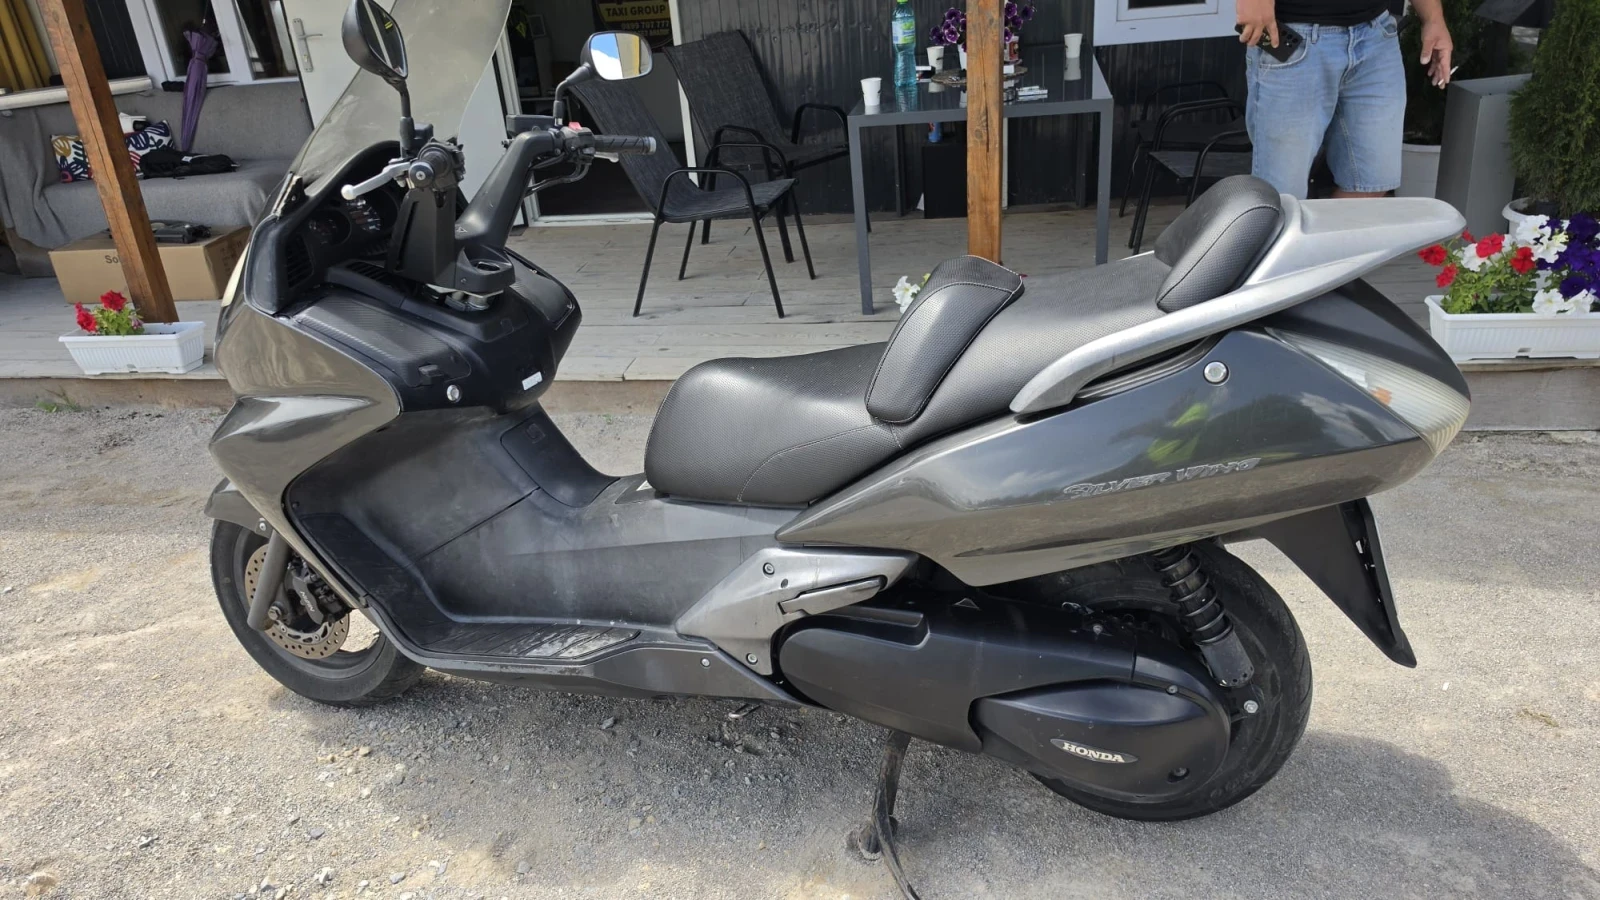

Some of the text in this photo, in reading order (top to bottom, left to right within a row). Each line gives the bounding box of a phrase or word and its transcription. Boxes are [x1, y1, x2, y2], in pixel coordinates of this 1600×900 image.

[605, 5, 666, 17] TAXI GROUP
[1063, 457, 1262, 500] SILVER WING
[1062, 742, 1126, 763] HONDA
